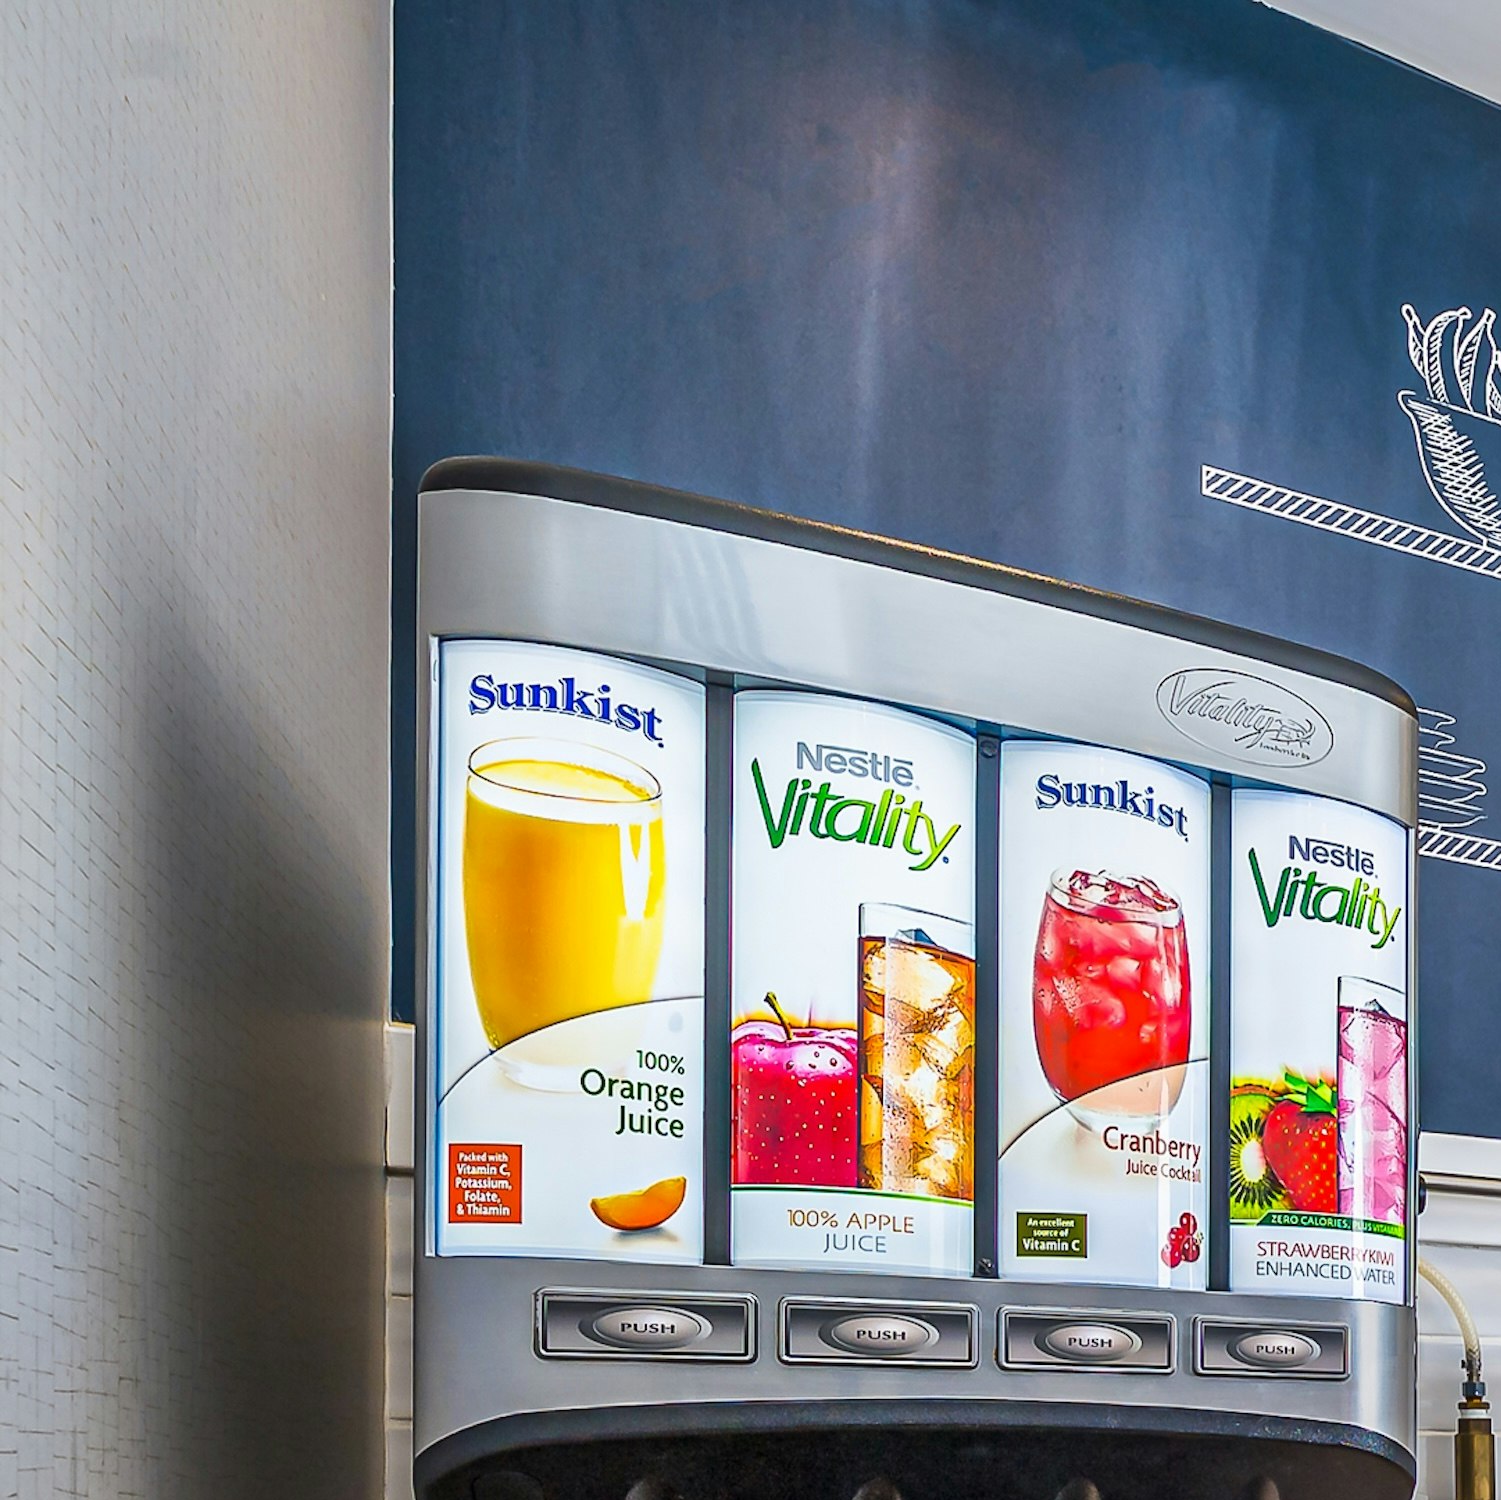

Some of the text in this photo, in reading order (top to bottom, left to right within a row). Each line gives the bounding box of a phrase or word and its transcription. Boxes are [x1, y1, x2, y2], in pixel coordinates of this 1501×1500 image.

[469, 674, 663, 742] Sunkist
[751, 757, 962, 871] Vitality
[1035, 774, 1189, 842] Sunkist
[1248, 847, 1402, 949] Vitality
[636, 1049, 685, 1075] 100%
[580, 1068, 685, 1112] Orange
[615, 1105, 685, 1138] Juice
[1103, 1126, 1201, 1168] Cranberry
[459, 1152, 509, 1162] Packed with
[456, 1163, 511, 1177] Vitamin C,
[1126, 1159, 1202, 1184] Juice Cocktail
[455, 1177, 512, 1191] Potassium,
[464, 1190, 501, 1203] Folate,
[456, 1203, 511, 1216] & Thiamin
[787, 1209, 915, 1234] 100% APPLE
[1027, 1217, 1075, 1228] An excellent
[1271, 1215, 1299, 1225] ZERO
[1033, 1228, 1069, 1237] source of
[823, 1233, 887, 1253] JUICE
[1022, 1237, 1081, 1252] Vitamin C
[1256, 1260, 1395, 1286] ENHANCED WATER
[620, 1320, 676, 1335] PUSH
[855, 1327, 907, 1342] PUSH
[1067, 1335, 1112, 1350] PUSH
[1256, 1343, 1295, 1356] PUSH
